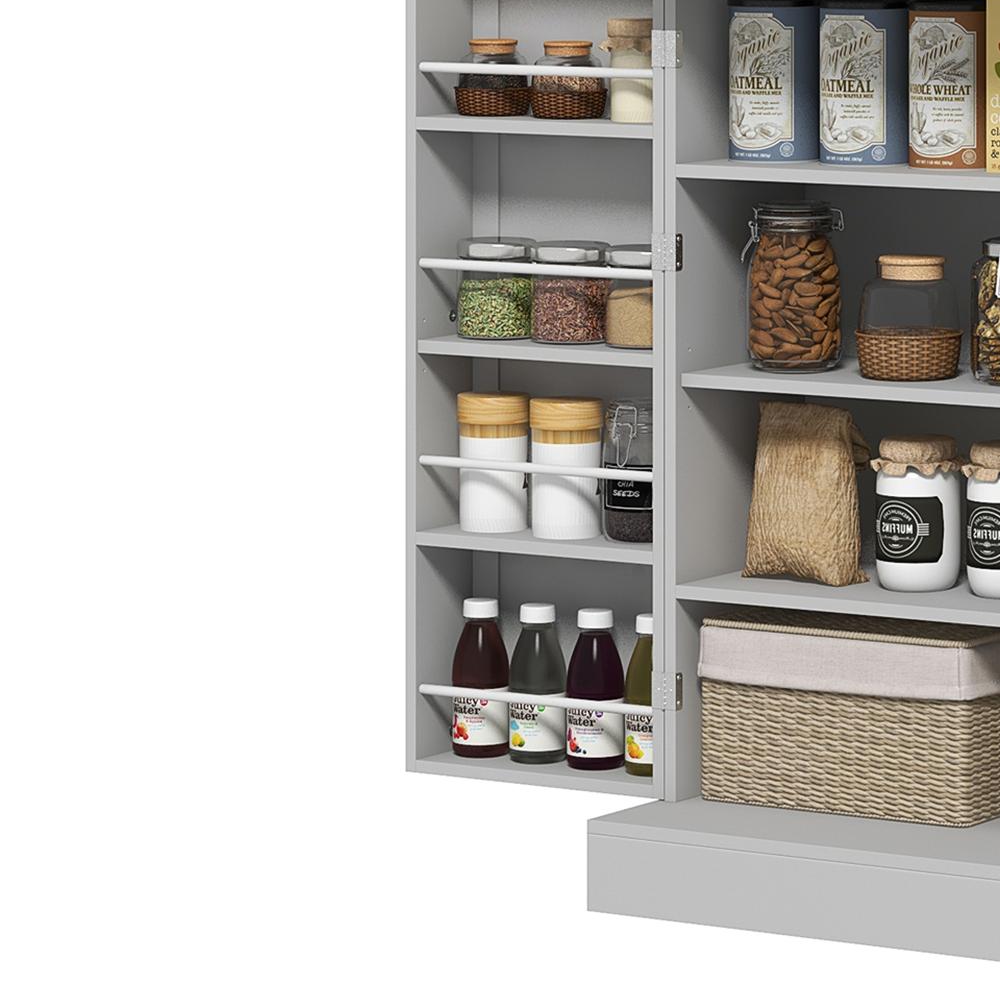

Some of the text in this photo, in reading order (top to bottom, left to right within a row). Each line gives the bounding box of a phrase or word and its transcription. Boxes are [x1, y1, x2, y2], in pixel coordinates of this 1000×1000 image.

[933, 84, 972, 96] WHEAT
[990, 149, 1000, 159] &
[612, 489, 640, 498] SEEDS
[453, 703, 481, 715] Water
[510, 709, 538, 721] Water
[567, 715, 596, 727] Water
[625, 720, 653, 733] Water
